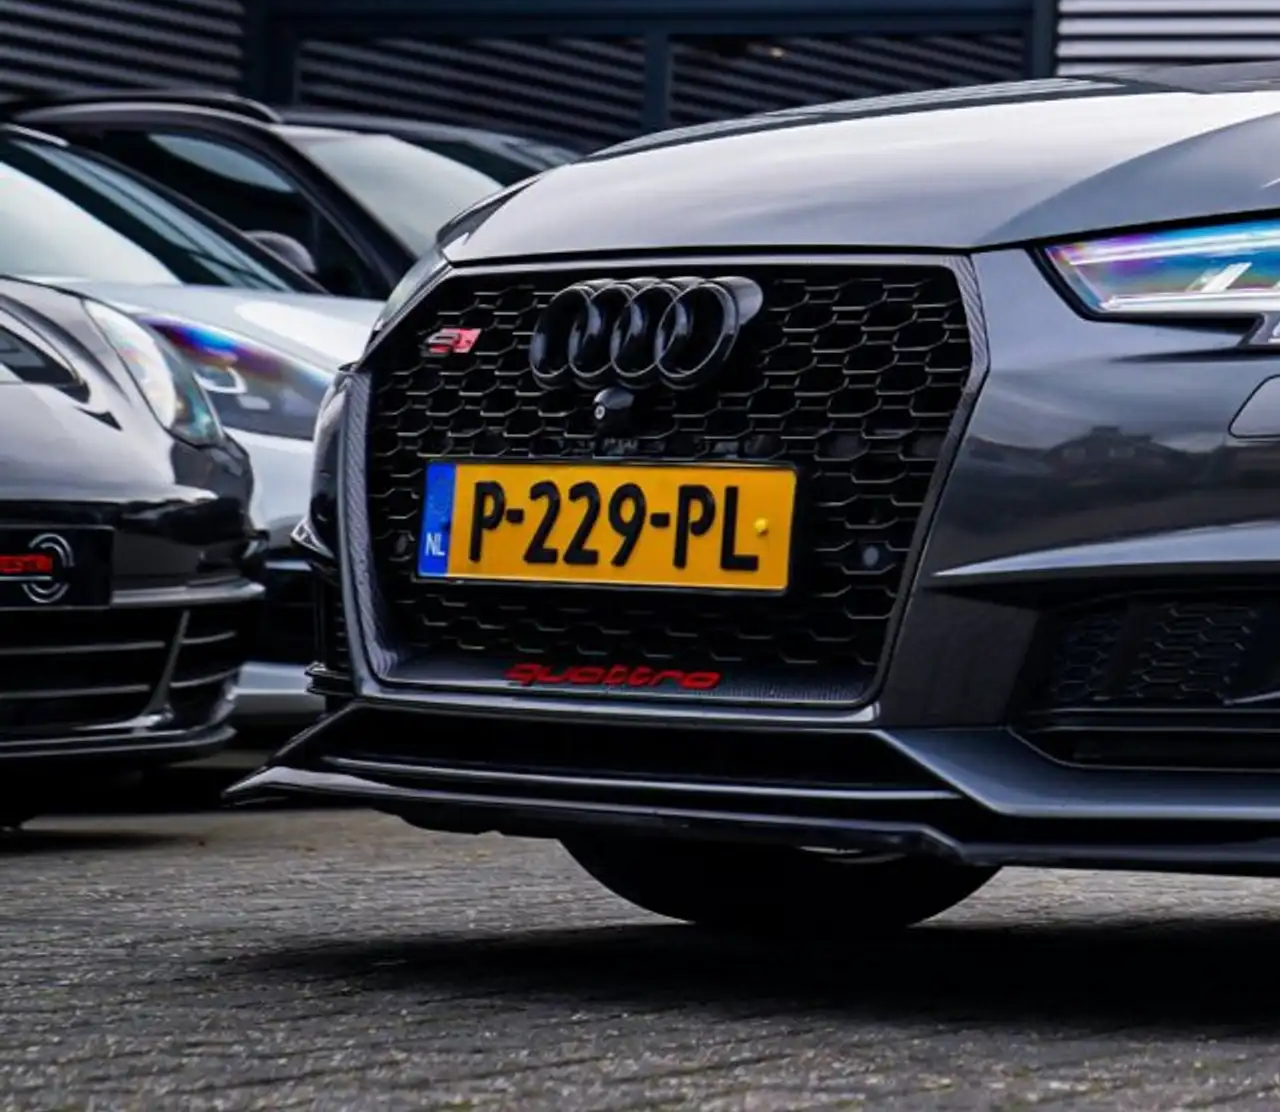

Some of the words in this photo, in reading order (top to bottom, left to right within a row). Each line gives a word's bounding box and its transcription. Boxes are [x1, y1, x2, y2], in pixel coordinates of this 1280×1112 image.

[425, 532, 446, 556] NL
[469, 480, 759, 572] P-229-PL
[503, 663, 721, 688] quattro
